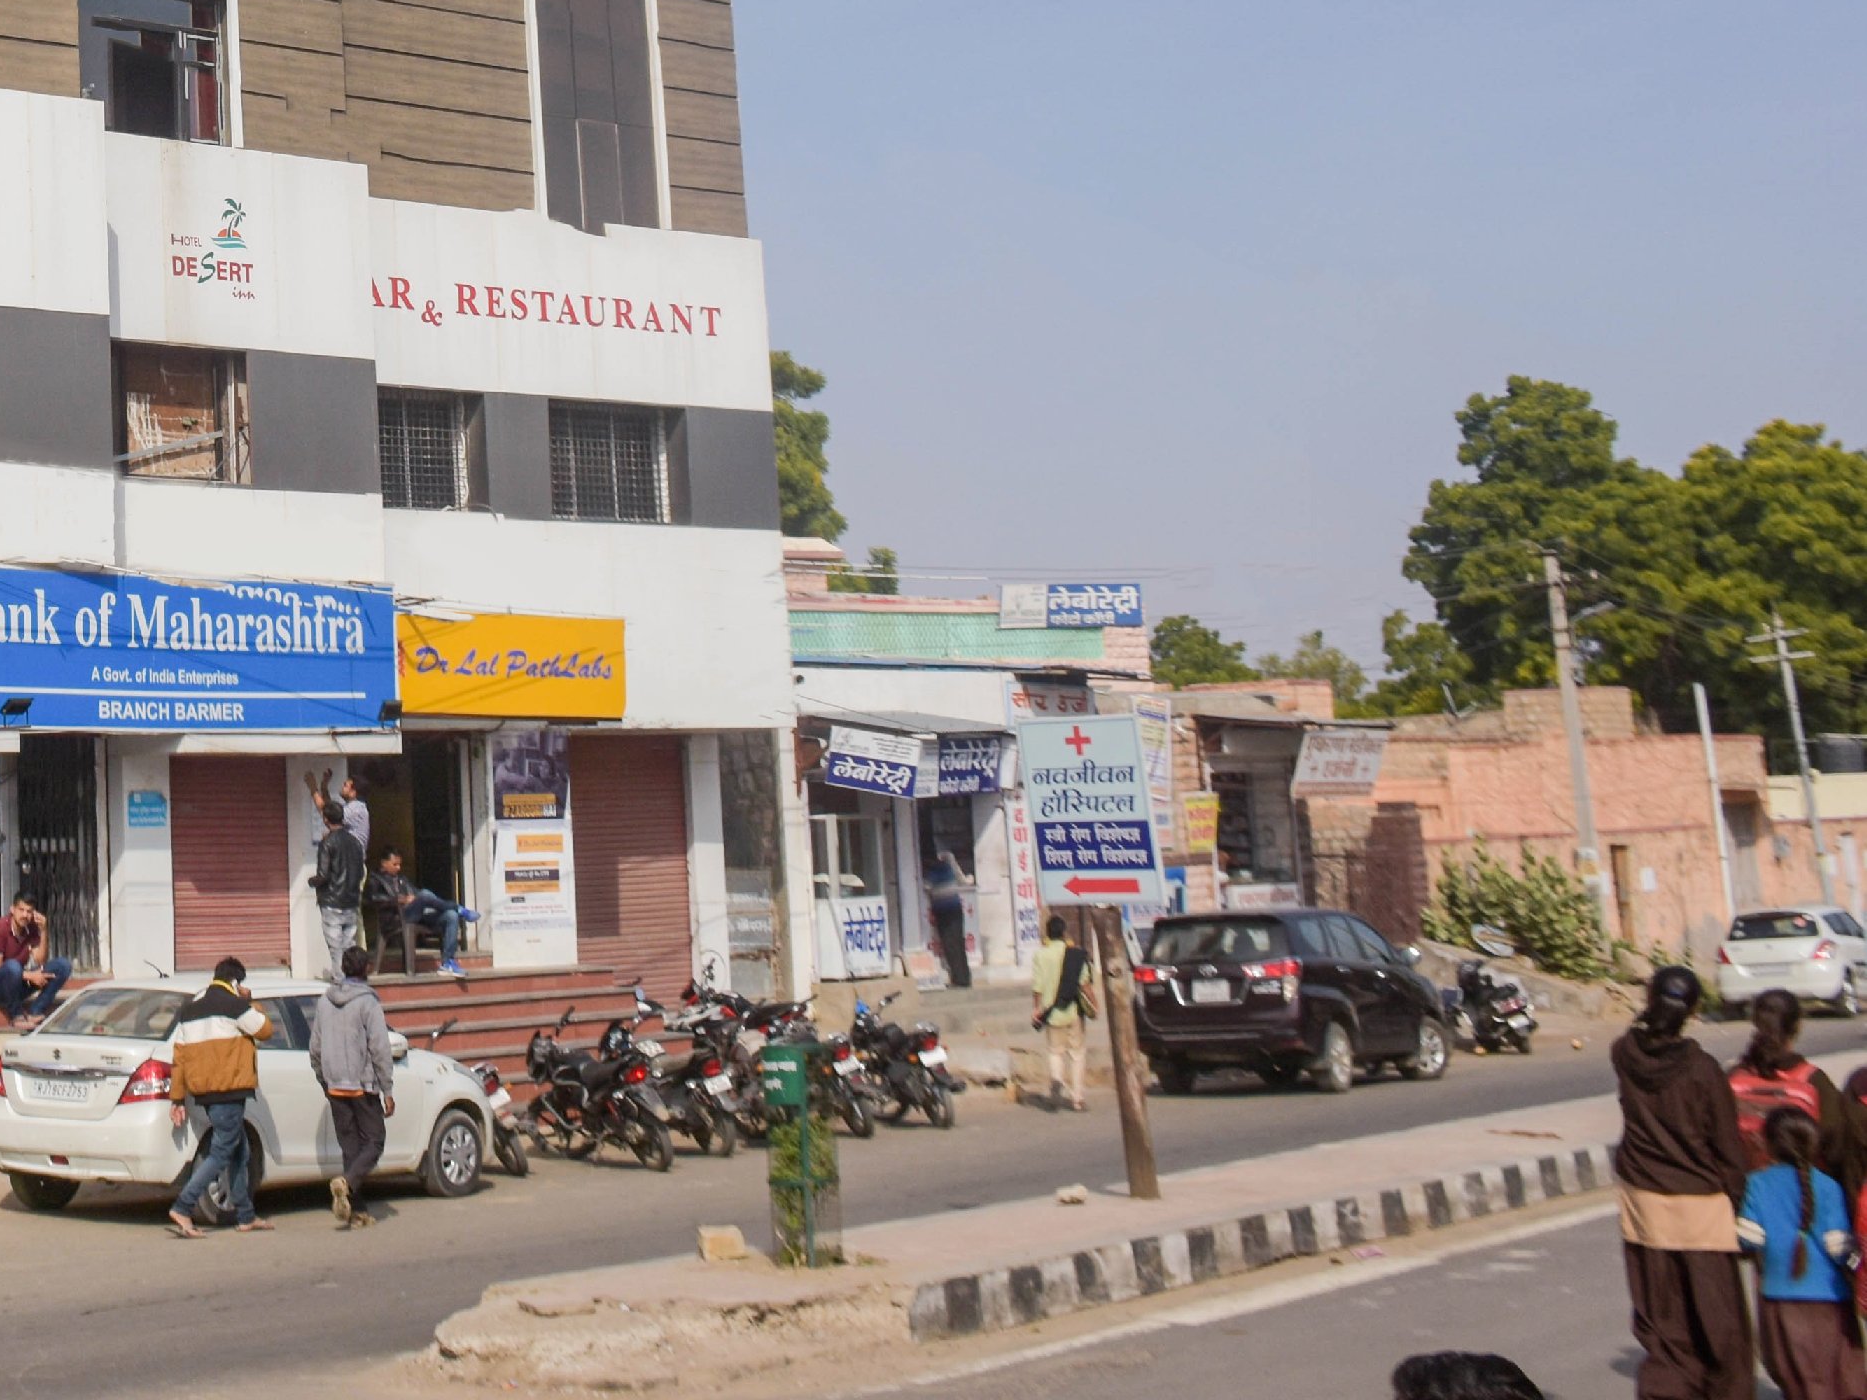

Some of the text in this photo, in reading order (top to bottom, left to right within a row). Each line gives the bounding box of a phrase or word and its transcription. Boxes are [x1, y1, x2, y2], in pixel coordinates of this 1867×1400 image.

[171, 251, 254, 283] DESERT
[420, 300, 443, 327] &
[454, 282, 722, 337] RESTAURANT
[75, 593, 117, 648] of
[127, 592, 365, 655] Maharashtra
[415, 646, 449, 674] Dr
[454, 649, 499, 676] Lal
[91, 666, 239, 688] A Govt. of India Enterprises
[98, 699, 245, 722] BRANCH BARMER
[1032, 759, 1137, 785] नवजीवन
